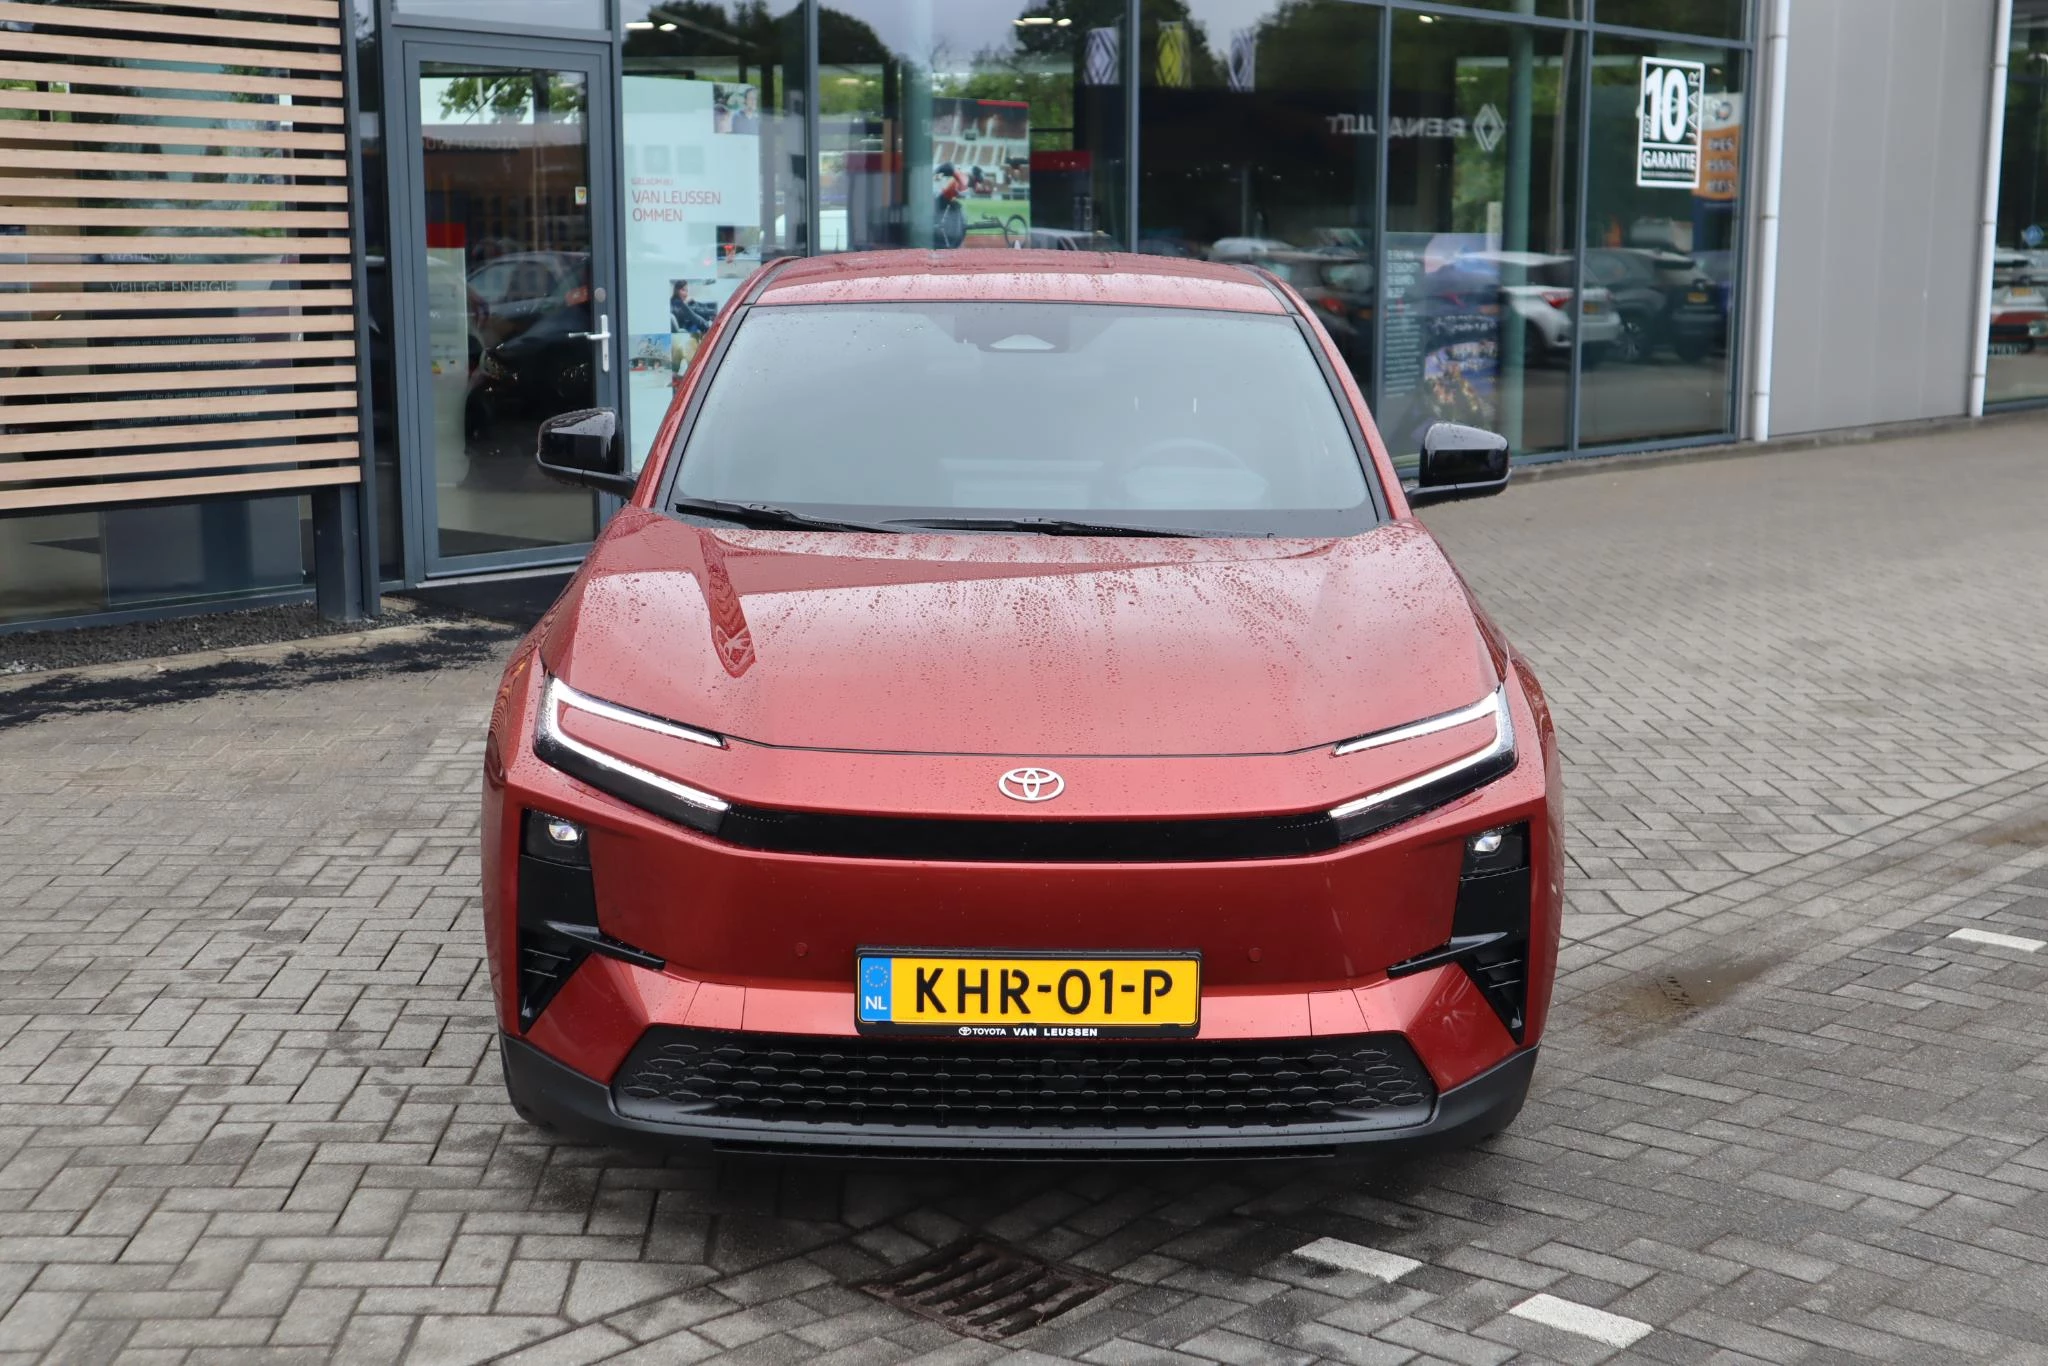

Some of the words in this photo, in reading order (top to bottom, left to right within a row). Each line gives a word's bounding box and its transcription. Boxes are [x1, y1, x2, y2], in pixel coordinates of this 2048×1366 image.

[1645, 66, 1688, 143] 10
[1686, 71, 1700, 143] JAAR
[1642, 150, 1697, 169] GARANTIE
[631, 190, 660, 205] VAN
[663, 190, 721, 205] LEUSSEN
[632, 207, 682, 222] OMMEN
[110, 280, 166, 292] VEILIGE
[172, 280, 233, 292] ENERGIE
[916, 967, 1173, 1015] KHR-01-P
[865, 996, 887, 1011] NL
[972, 1027, 1007, 1036] TOYOTA
[1013, 1028, 1037, 1037] VAN
[1043, 1028, 1098, 1037] LEUSSEN
